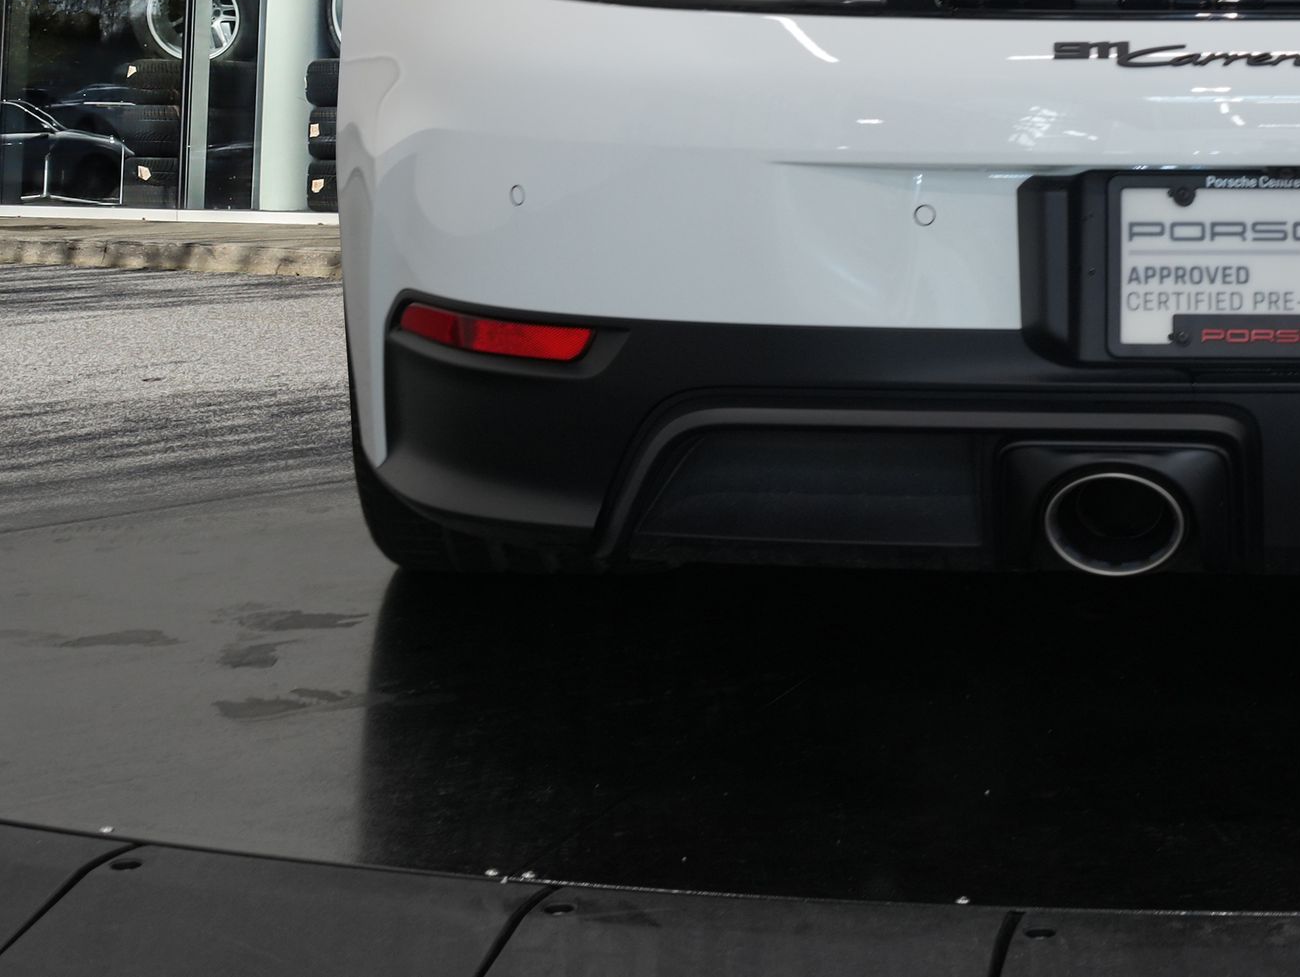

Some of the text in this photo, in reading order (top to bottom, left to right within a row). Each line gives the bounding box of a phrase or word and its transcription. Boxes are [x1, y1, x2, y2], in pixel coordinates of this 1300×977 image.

[1206, 176, 1257, 188] Porsche
[1127, 266, 1250, 285] APPROVED
[1126, 291, 1244, 312] CERTIFIED
